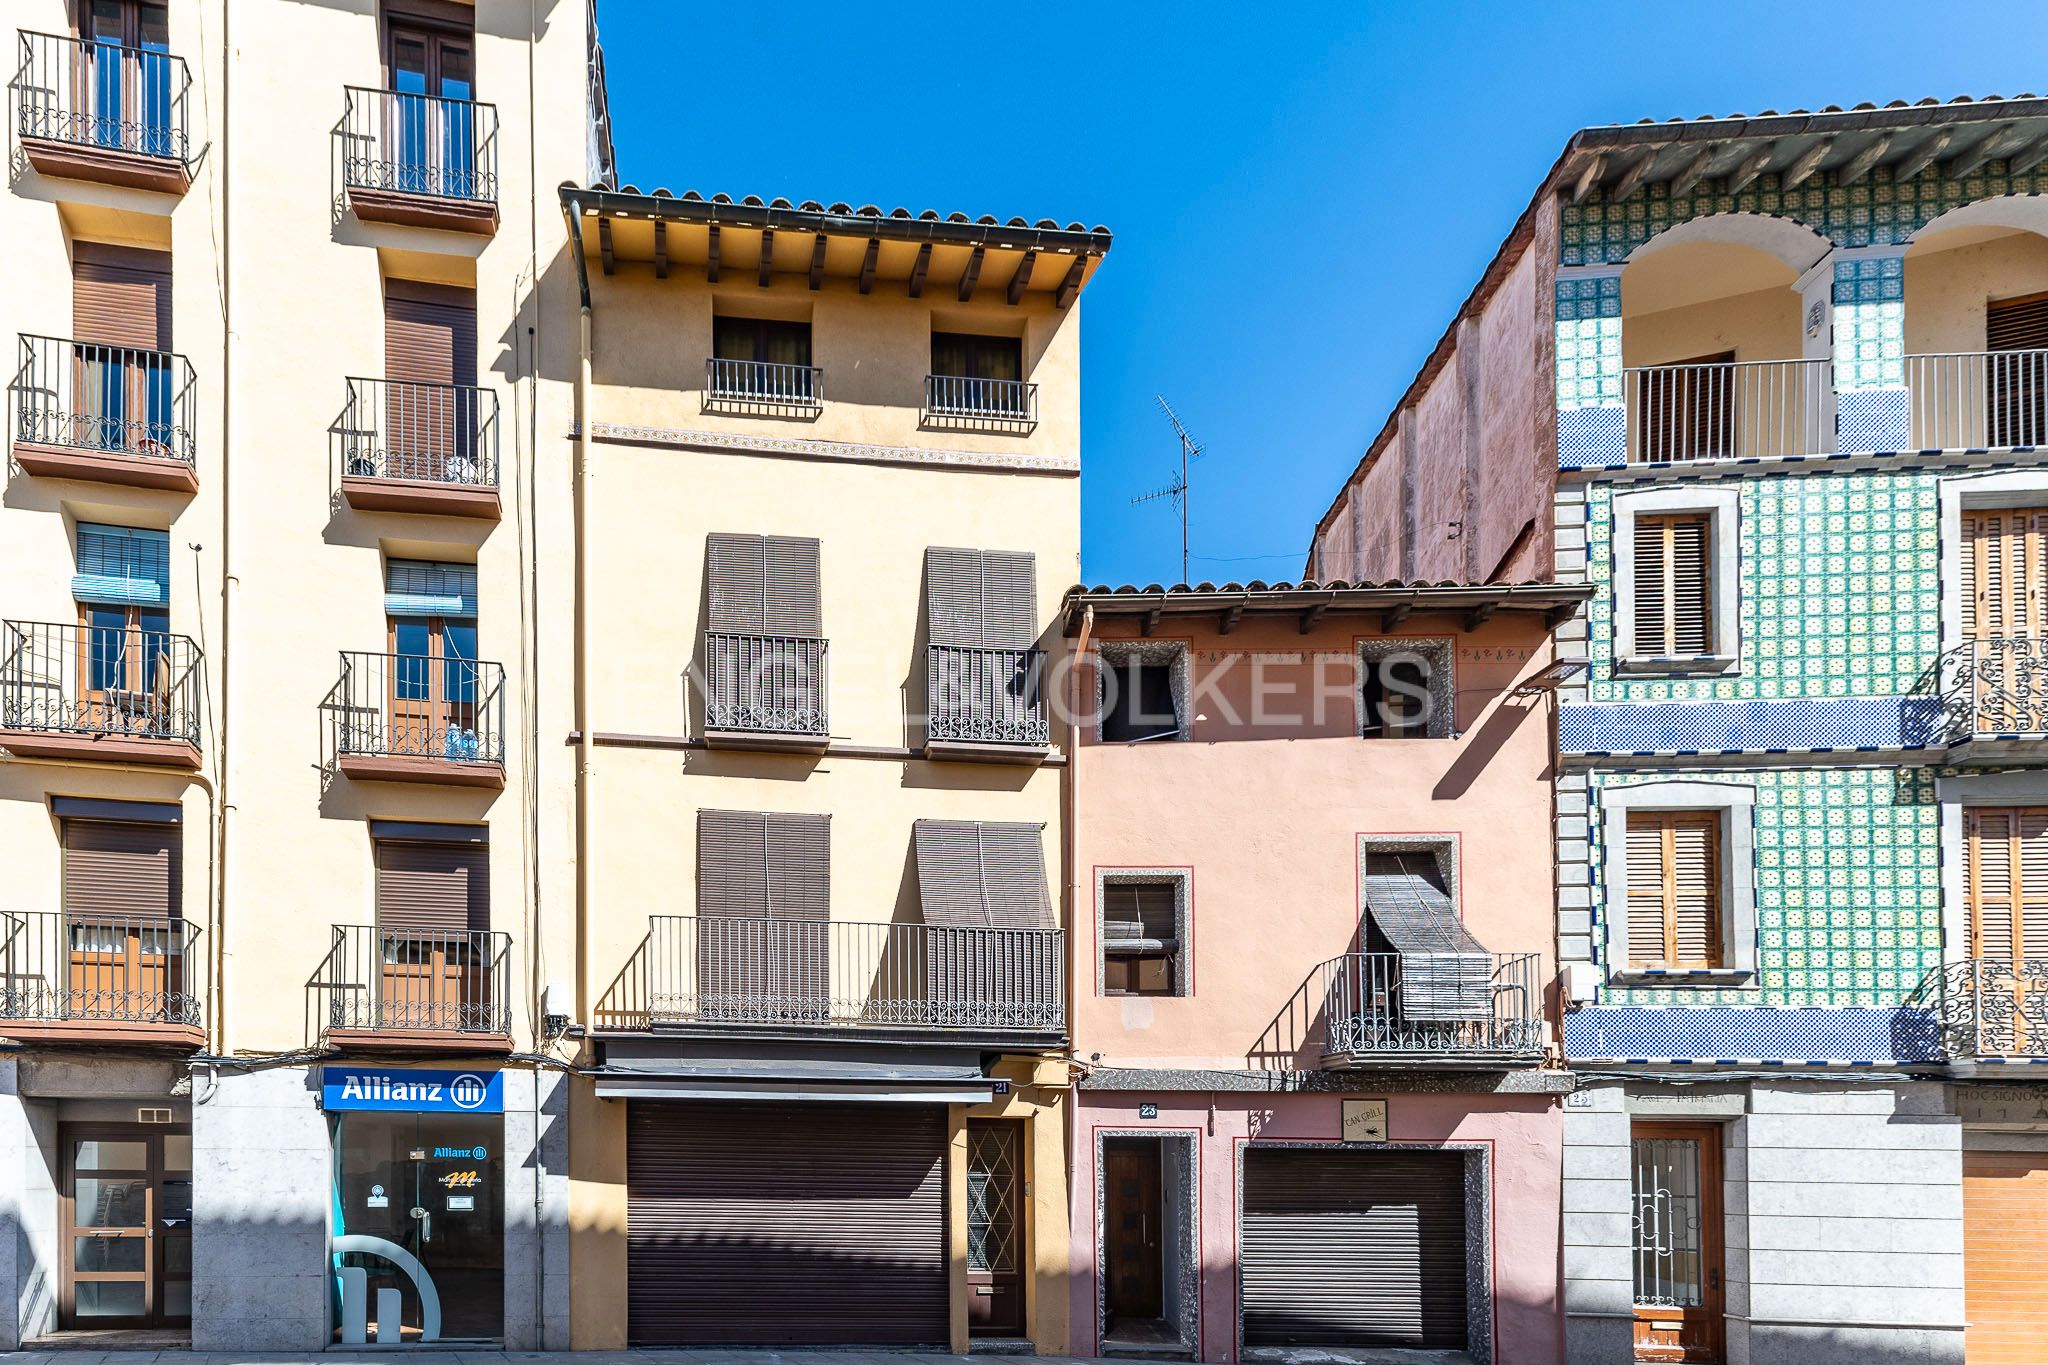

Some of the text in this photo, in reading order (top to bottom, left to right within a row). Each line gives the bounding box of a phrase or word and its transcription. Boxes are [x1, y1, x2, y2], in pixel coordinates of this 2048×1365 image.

[340, 1075, 443, 1102] Allianz
[995, 1082, 1007, 1093] 21
[1955, 1090, 1988, 1101] HOC
[1141, 1104, 1155, 1116] 23
[1345, 1115, 1361, 1127] CAN
[433, 1147, 471, 1158] Allianz
